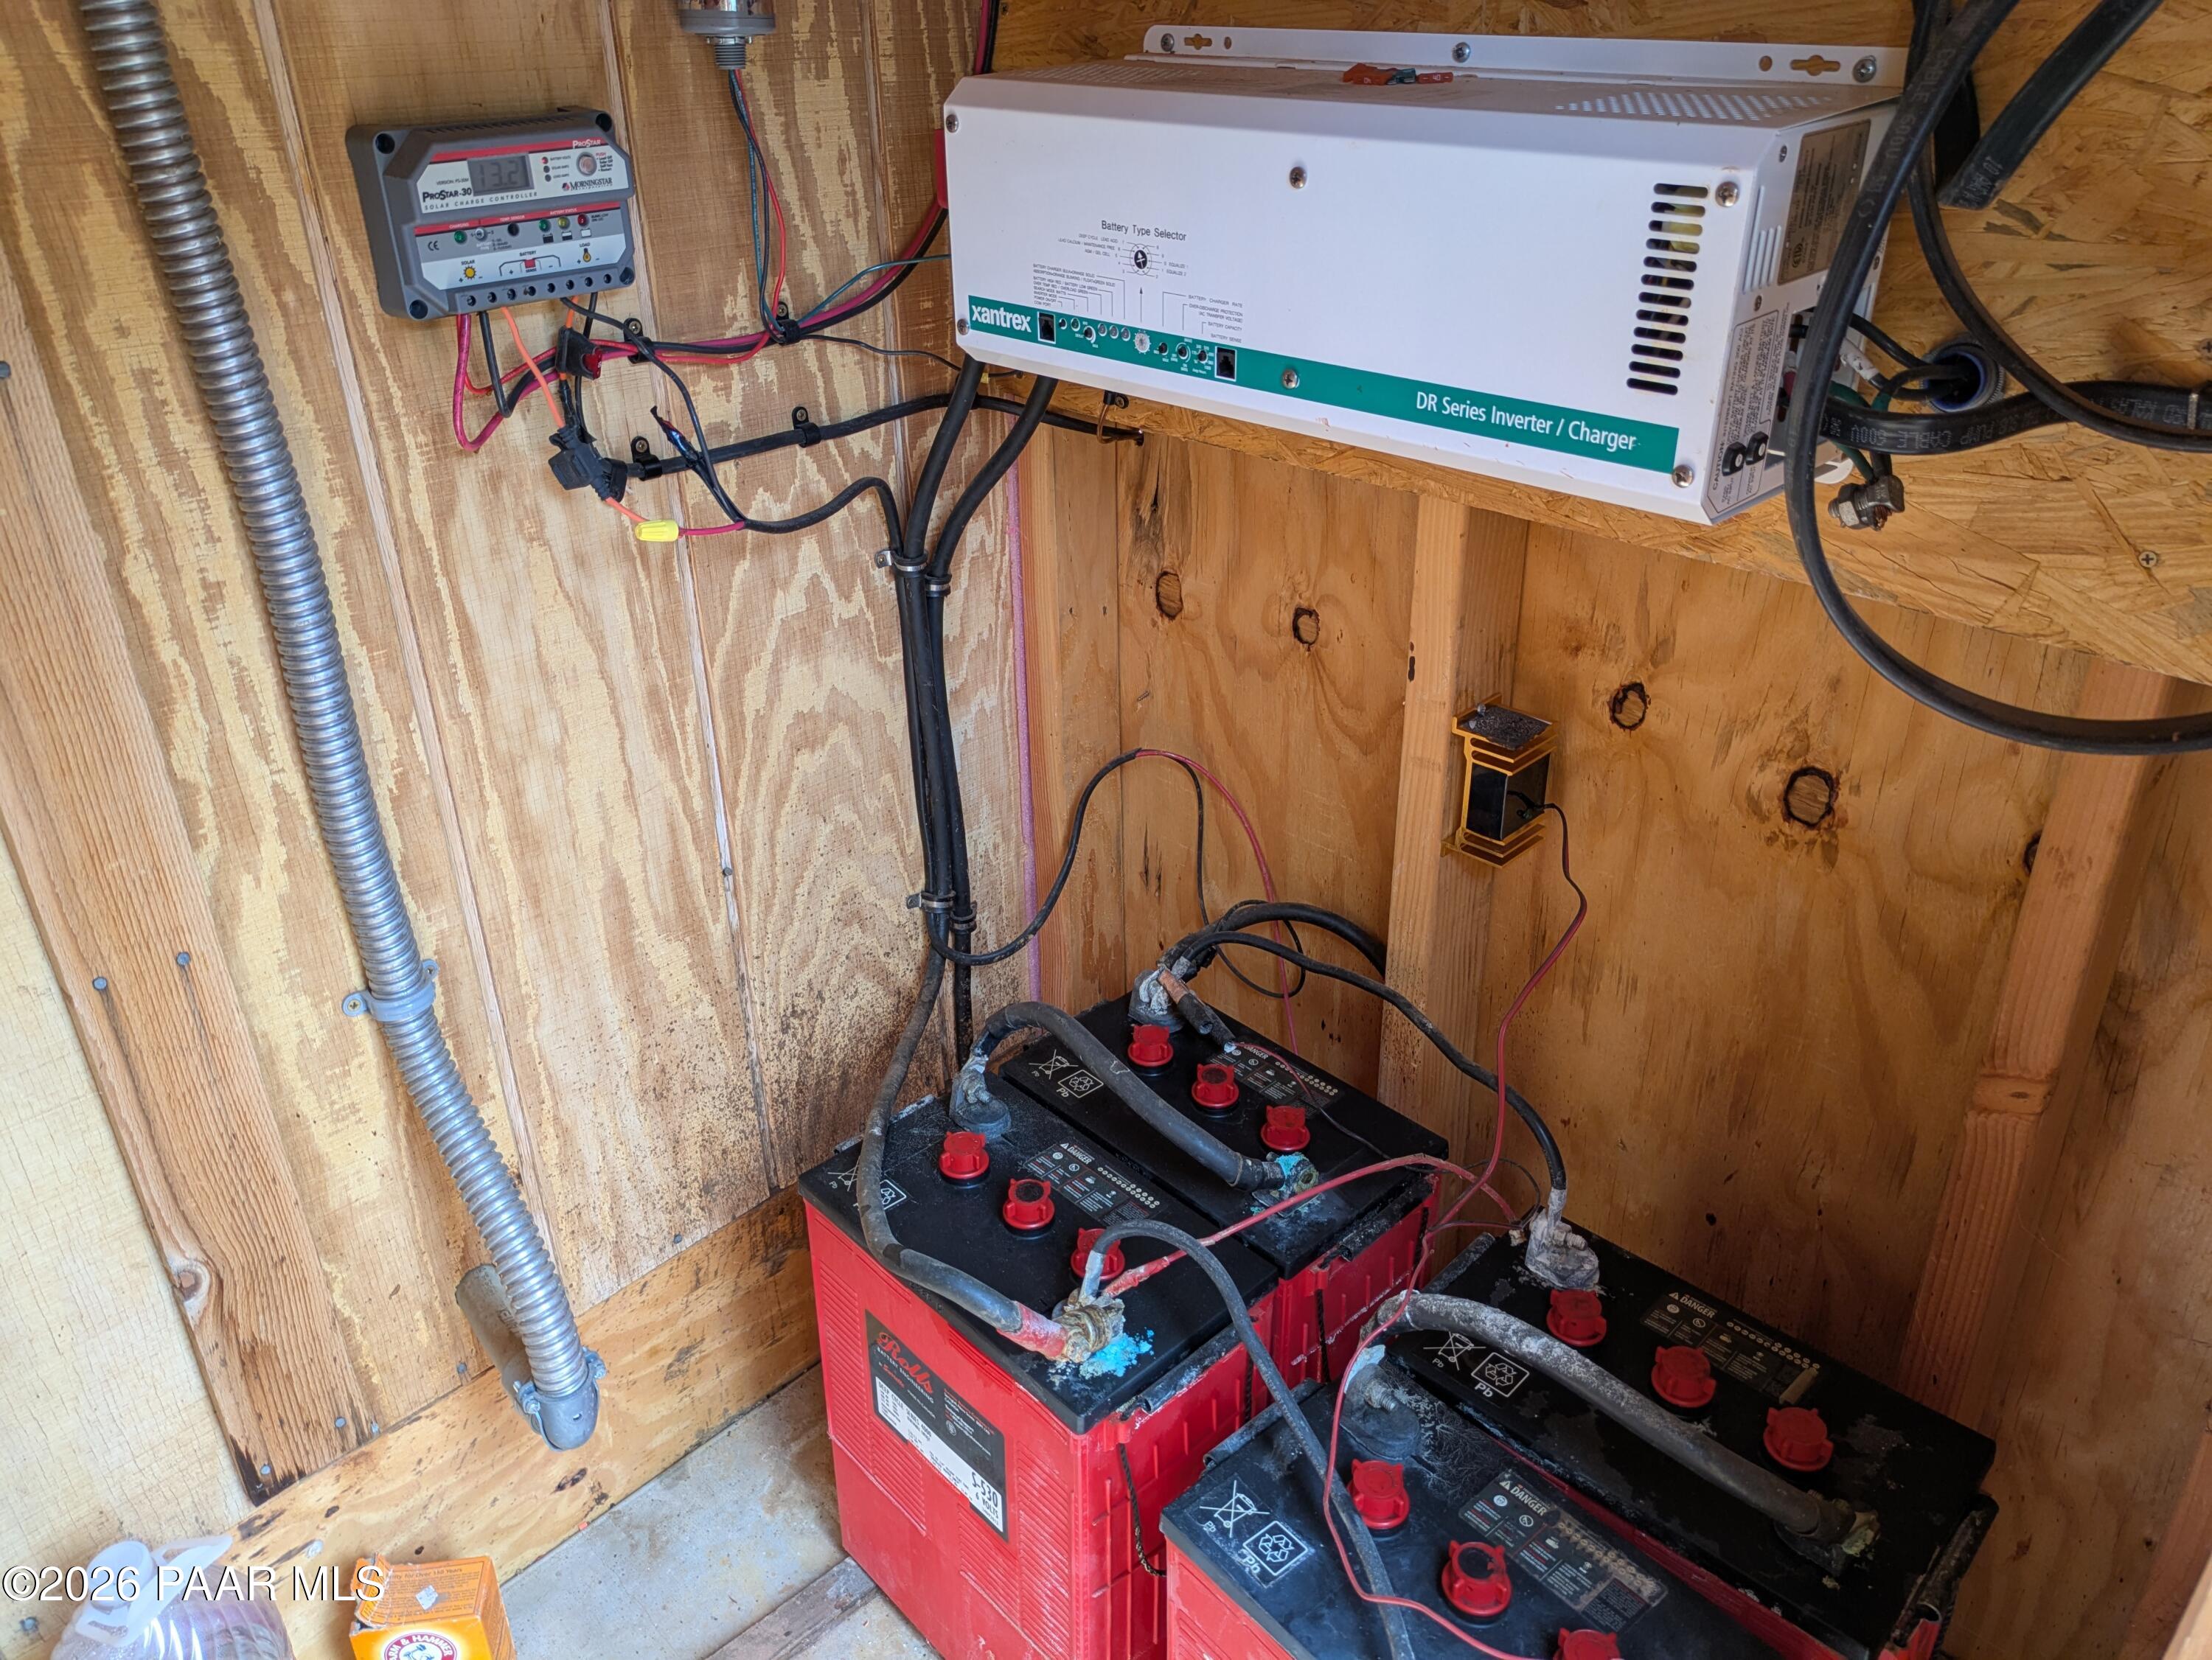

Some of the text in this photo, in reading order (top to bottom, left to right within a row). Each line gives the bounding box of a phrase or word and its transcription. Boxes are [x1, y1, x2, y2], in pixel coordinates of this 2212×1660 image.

[479, 159, 520, 189] 13.2
[425, 192, 538, 211] SOLAR CHARGE CONTROLLER
[1102, 220, 1186, 241] Battery Type Selector
[971, 304, 1032, 332] xantrex
[1416, 391, 1636, 453] DR Series Inverter / Charger
[1896, 430, 1952, 449] CABLE
[1056, 1087, 1069, 1097] Pb
[1068, 1146, 1092, 1165] DANGER
[1680, 1295, 1716, 1319] DANGER
[1432, 1358, 1444, 1367] Pb
[879, 1381, 890, 1398] DEEP
[891, 1390, 904, 1410] CYCLE
[1474, 1382, 1493, 1397] Pb
[972, 1471, 998, 1508] S-530
[981, 1497, 999, 1519] VOLTS
[1510, 1485, 1548, 1517] DANGER
[1242, 1555, 1261, 1574] Pb
[400, 1638, 411, 1646] &
[411, 1635, 453, 1657] HAMMER
